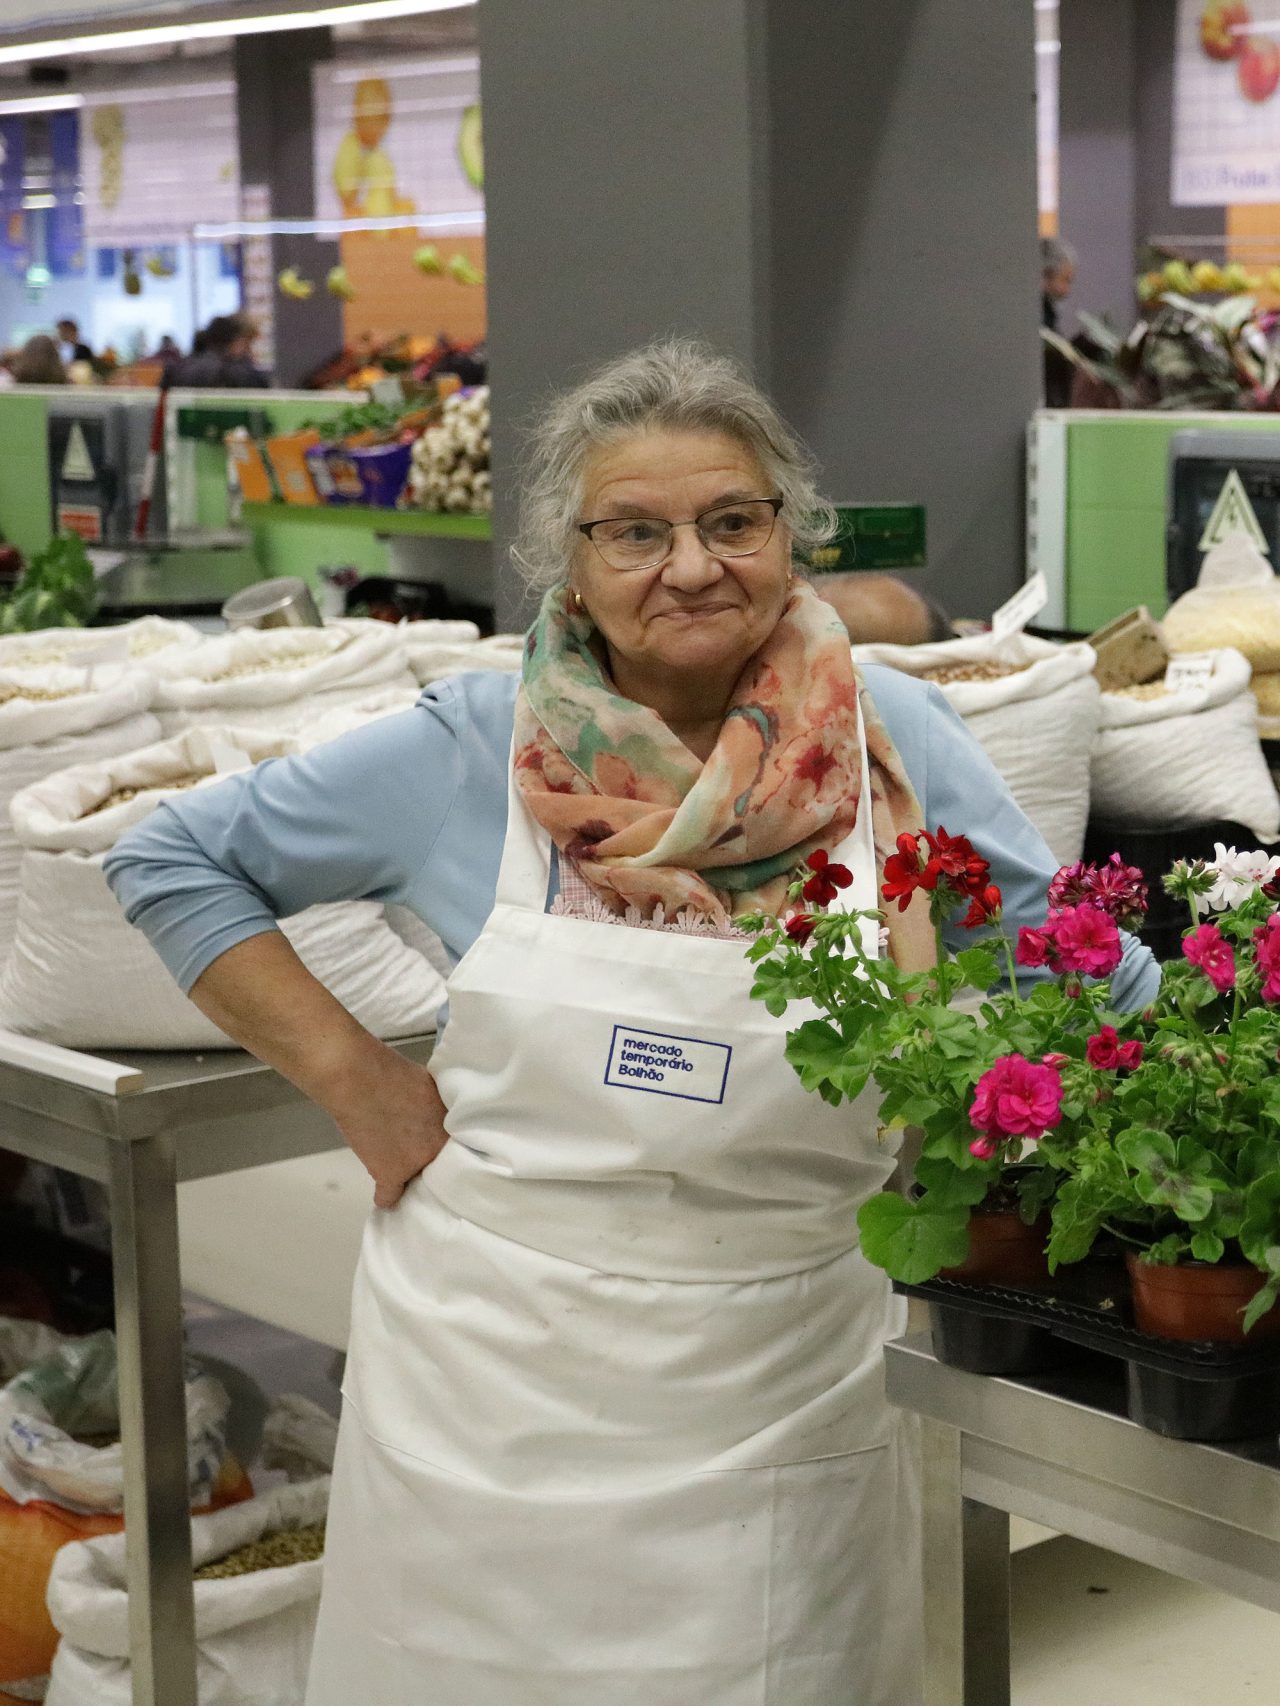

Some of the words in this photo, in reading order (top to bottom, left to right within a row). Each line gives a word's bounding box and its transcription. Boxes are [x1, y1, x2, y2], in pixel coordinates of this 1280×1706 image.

[623, 1038, 683, 1057] mercado
[621, 1050, 694, 1072] temporário
[618, 1064, 664, 1081] Bolhão
